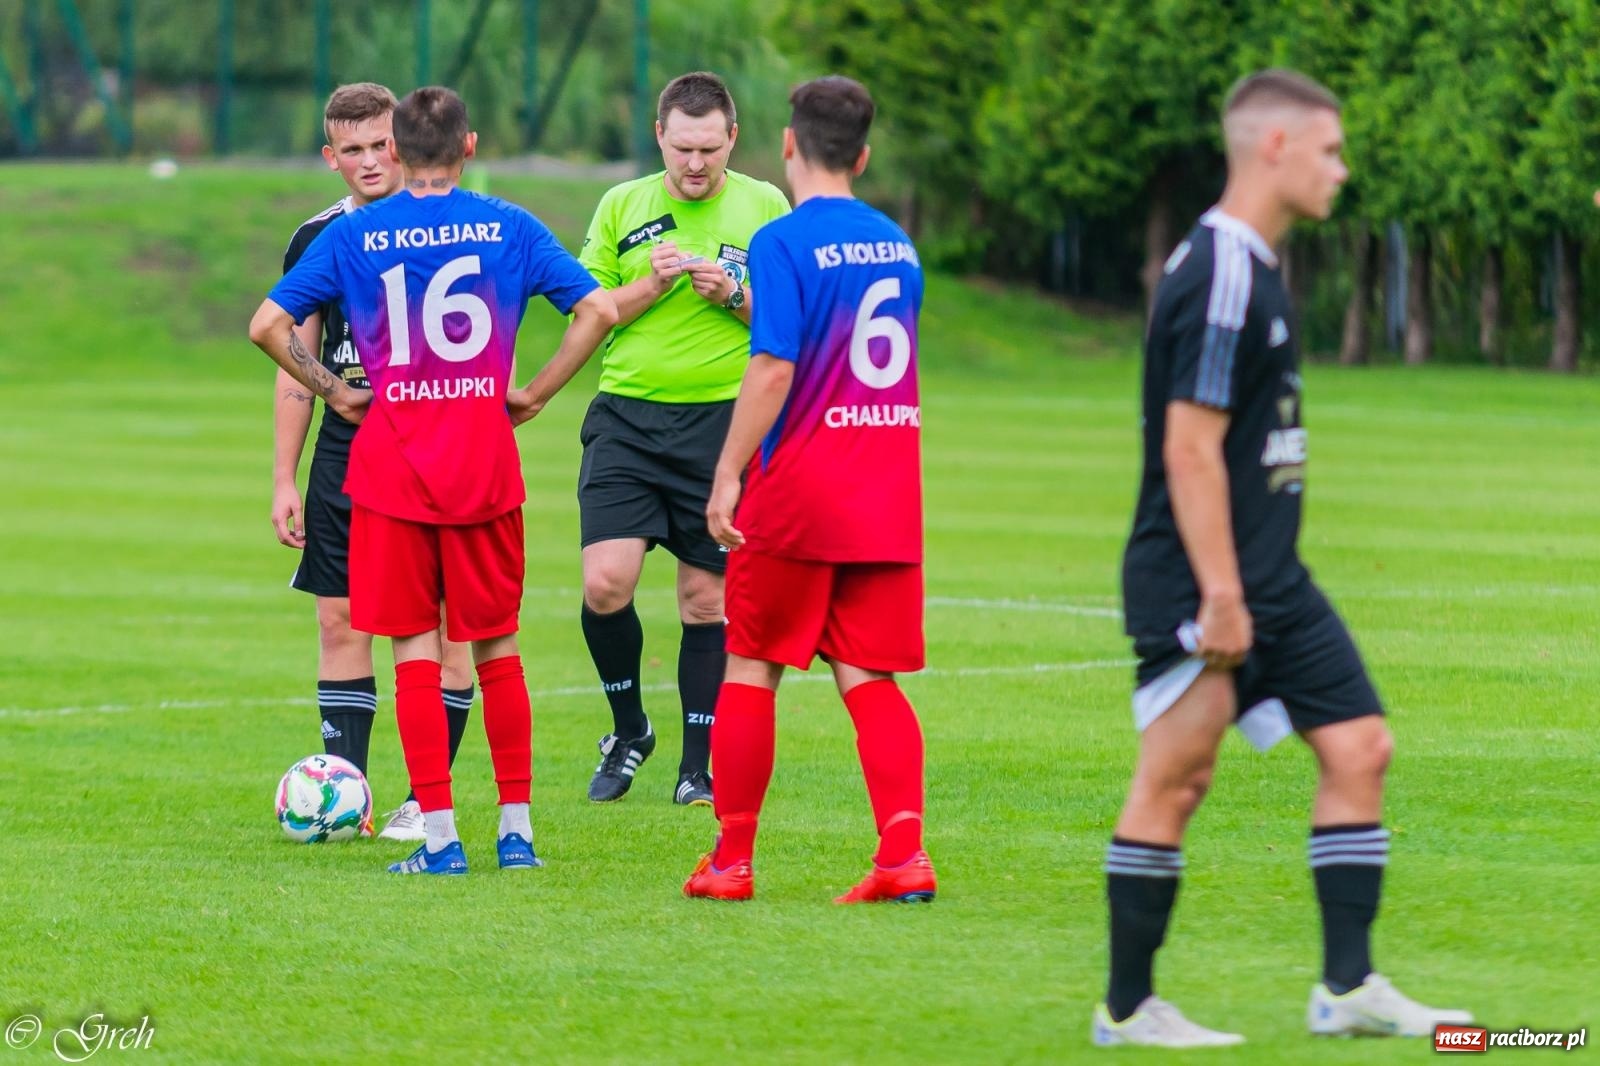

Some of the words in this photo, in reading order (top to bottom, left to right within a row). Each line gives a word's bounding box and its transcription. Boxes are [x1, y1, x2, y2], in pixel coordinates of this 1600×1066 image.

[364, 231, 389, 252] KS
[395, 222, 502, 249] KOLEJARZ
[814, 244, 842, 270] KS
[380, 255, 492, 367] 16
[849, 277, 911, 390] 6
[386, 377, 495, 402] CHAŁUPKI
[824, 404, 920, 428] CHAŁUPK
